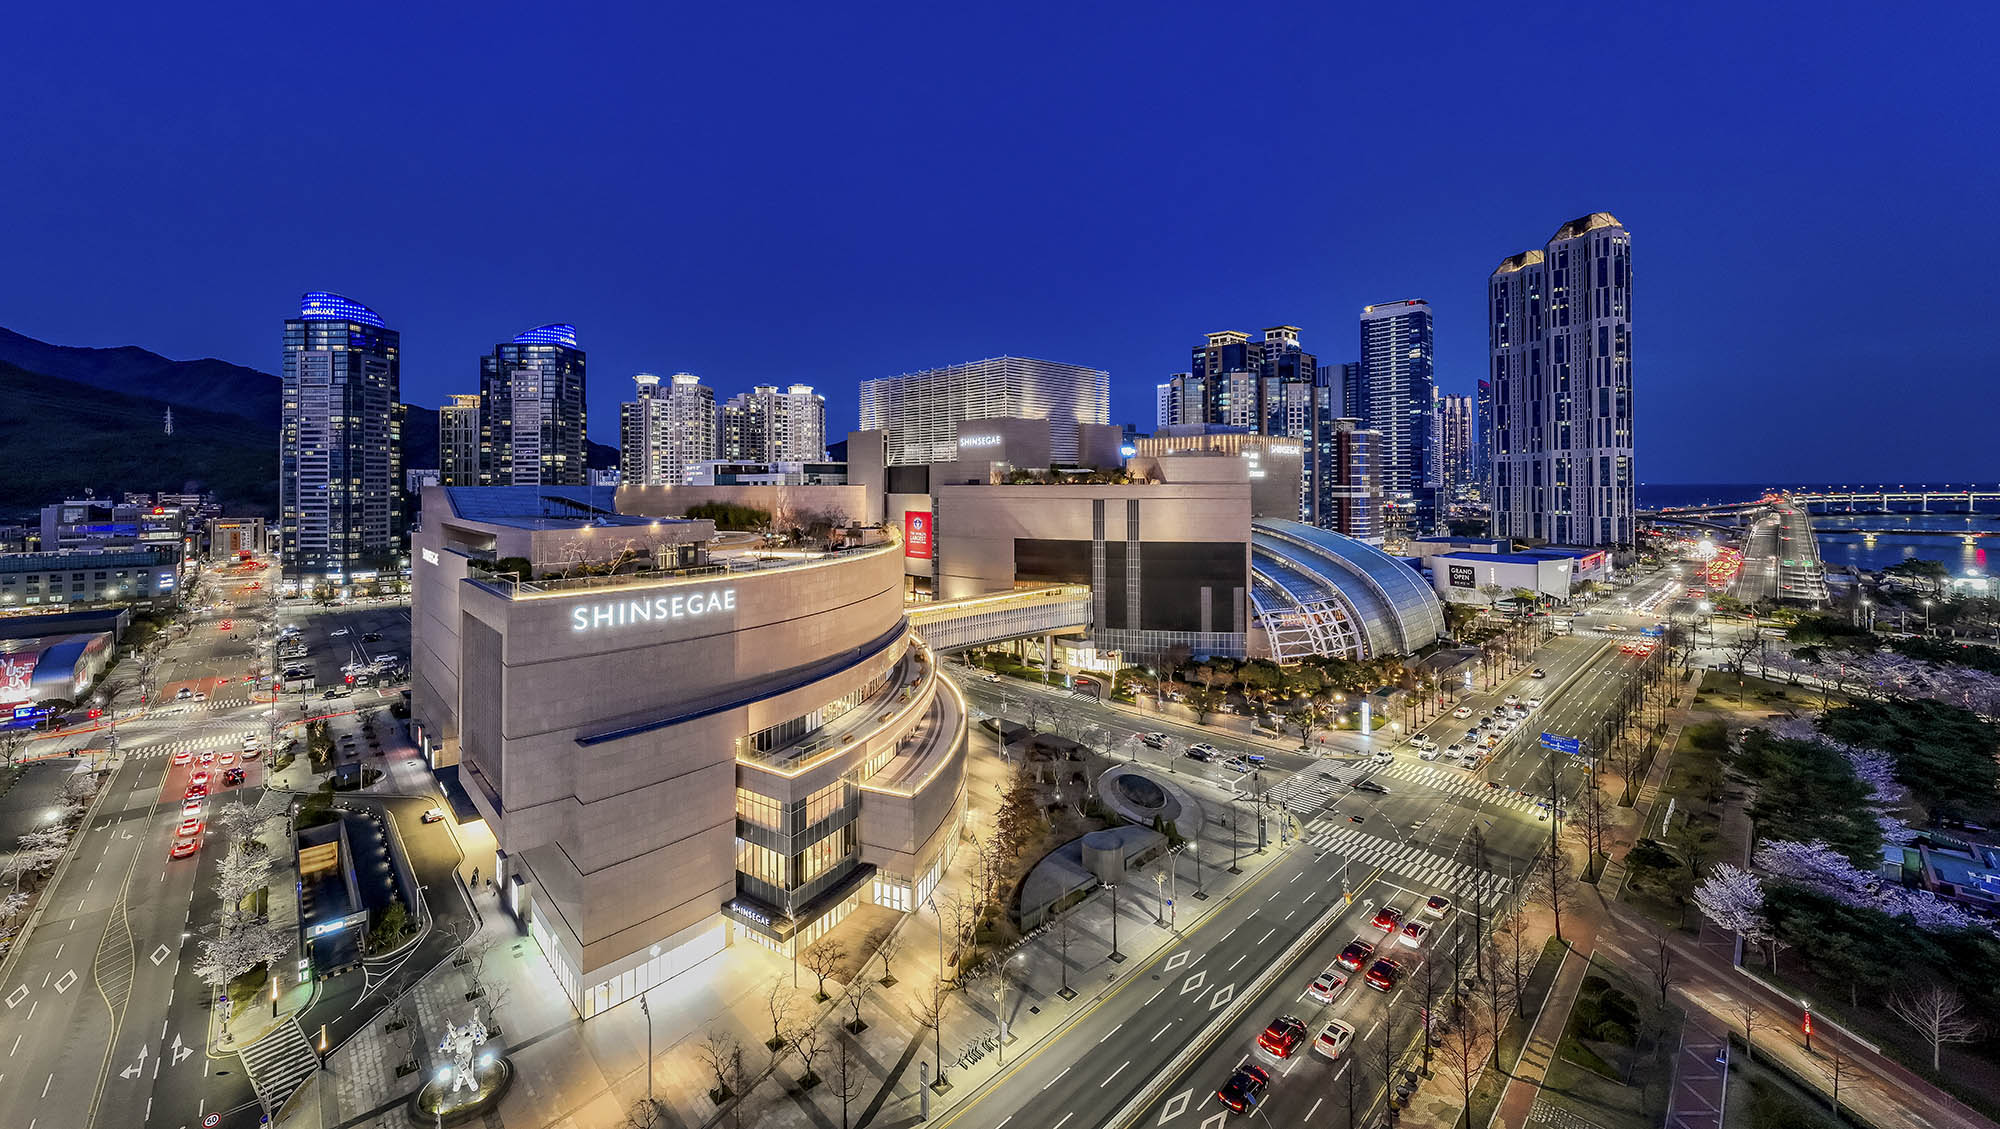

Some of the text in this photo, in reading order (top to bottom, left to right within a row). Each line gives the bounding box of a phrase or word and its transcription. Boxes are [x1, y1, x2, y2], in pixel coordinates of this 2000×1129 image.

[960, 436, 1001, 446] SHINSEGAE
[573, 589, 736, 631] SHINSEGAE
[732, 903, 770, 927] SHINSEGAE
